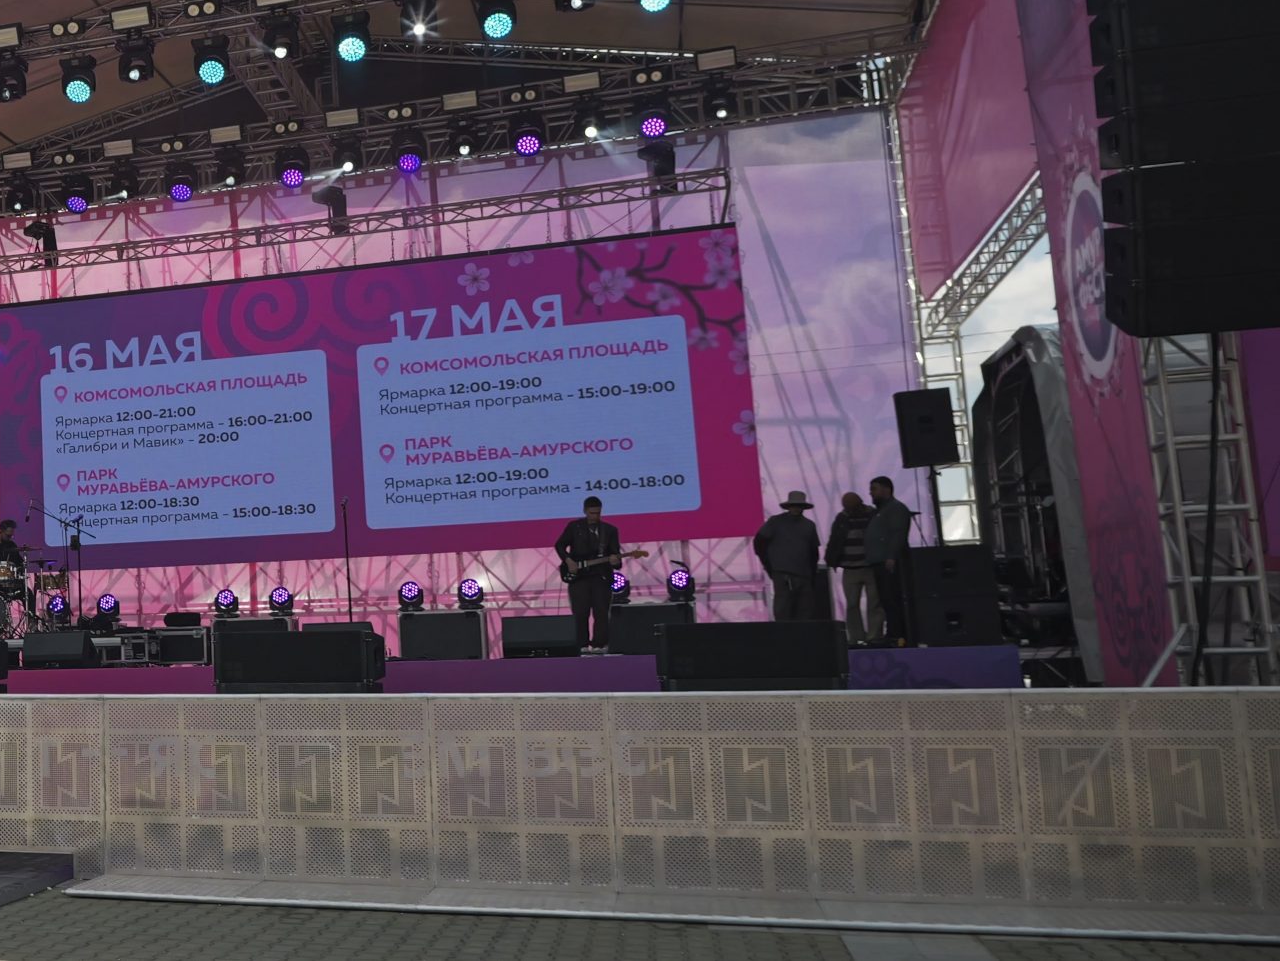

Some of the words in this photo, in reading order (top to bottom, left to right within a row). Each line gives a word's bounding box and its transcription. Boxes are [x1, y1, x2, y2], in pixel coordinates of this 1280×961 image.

[389, 308, 437, 342] 17
[451, 294, 564, 336] МАЯ
[49, 342, 93, 374] 16
[106, 331, 202, 370] МАЯ
[399, 348, 564, 375] КОМСОМОЛЬСКАЯ
[568, 339, 669, 360] ПЛОЩАДЬ
[74, 380, 217, 403] КОМСОМОЛЬСКАЯ
[221, 372, 308, 392] ПЛОЩАДЬ
[378, 385, 446, 401] Ярмарка
[449, 376, 542, 395] 12:00-19:00
[380, 400, 470, 418] Концертная
[474, 392, 563, 410] программа
[577, 380, 676, 400] 15:00-19:00
[55, 413, 113, 429] Ярмарка
[116, 406, 196, 422] 12:00-21:00
[56, 425, 134, 442] Концертная
[138, 420, 214, 437] программа
[228, 410, 313, 428] 16:00-21:00
[56, 441, 118, 454] «Галибри
[121, 441, 129, 450] и
[133, 436, 184, 450] Мавик»
[198, 431, 239, 444] 20:00
[405, 435, 452, 450] ПАРК
[405, 438, 634, 466] МУРАВЬЁВА-АМУРСКОГО
[77, 468, 117, 482] ПАРК
[77, 472, 275, 496] МУРАВЬЁВА-АМУРСКОГО
[384, 474, 451, 491] Ярмарка
[455, 467, 549, 485] 12:00-19:00
[385, 488, 476, 505] Концертная
[481, 483, 570, 500] программа
[585, 474, 685, 492] 14:00-18:00
[59, 503, 117, 516] Ярмарка
[120, 496, 199, 511] 12:00-18:30
[143, 510, 218, 525] программа
[232, 503, 316, 519] 15:00-18:30
